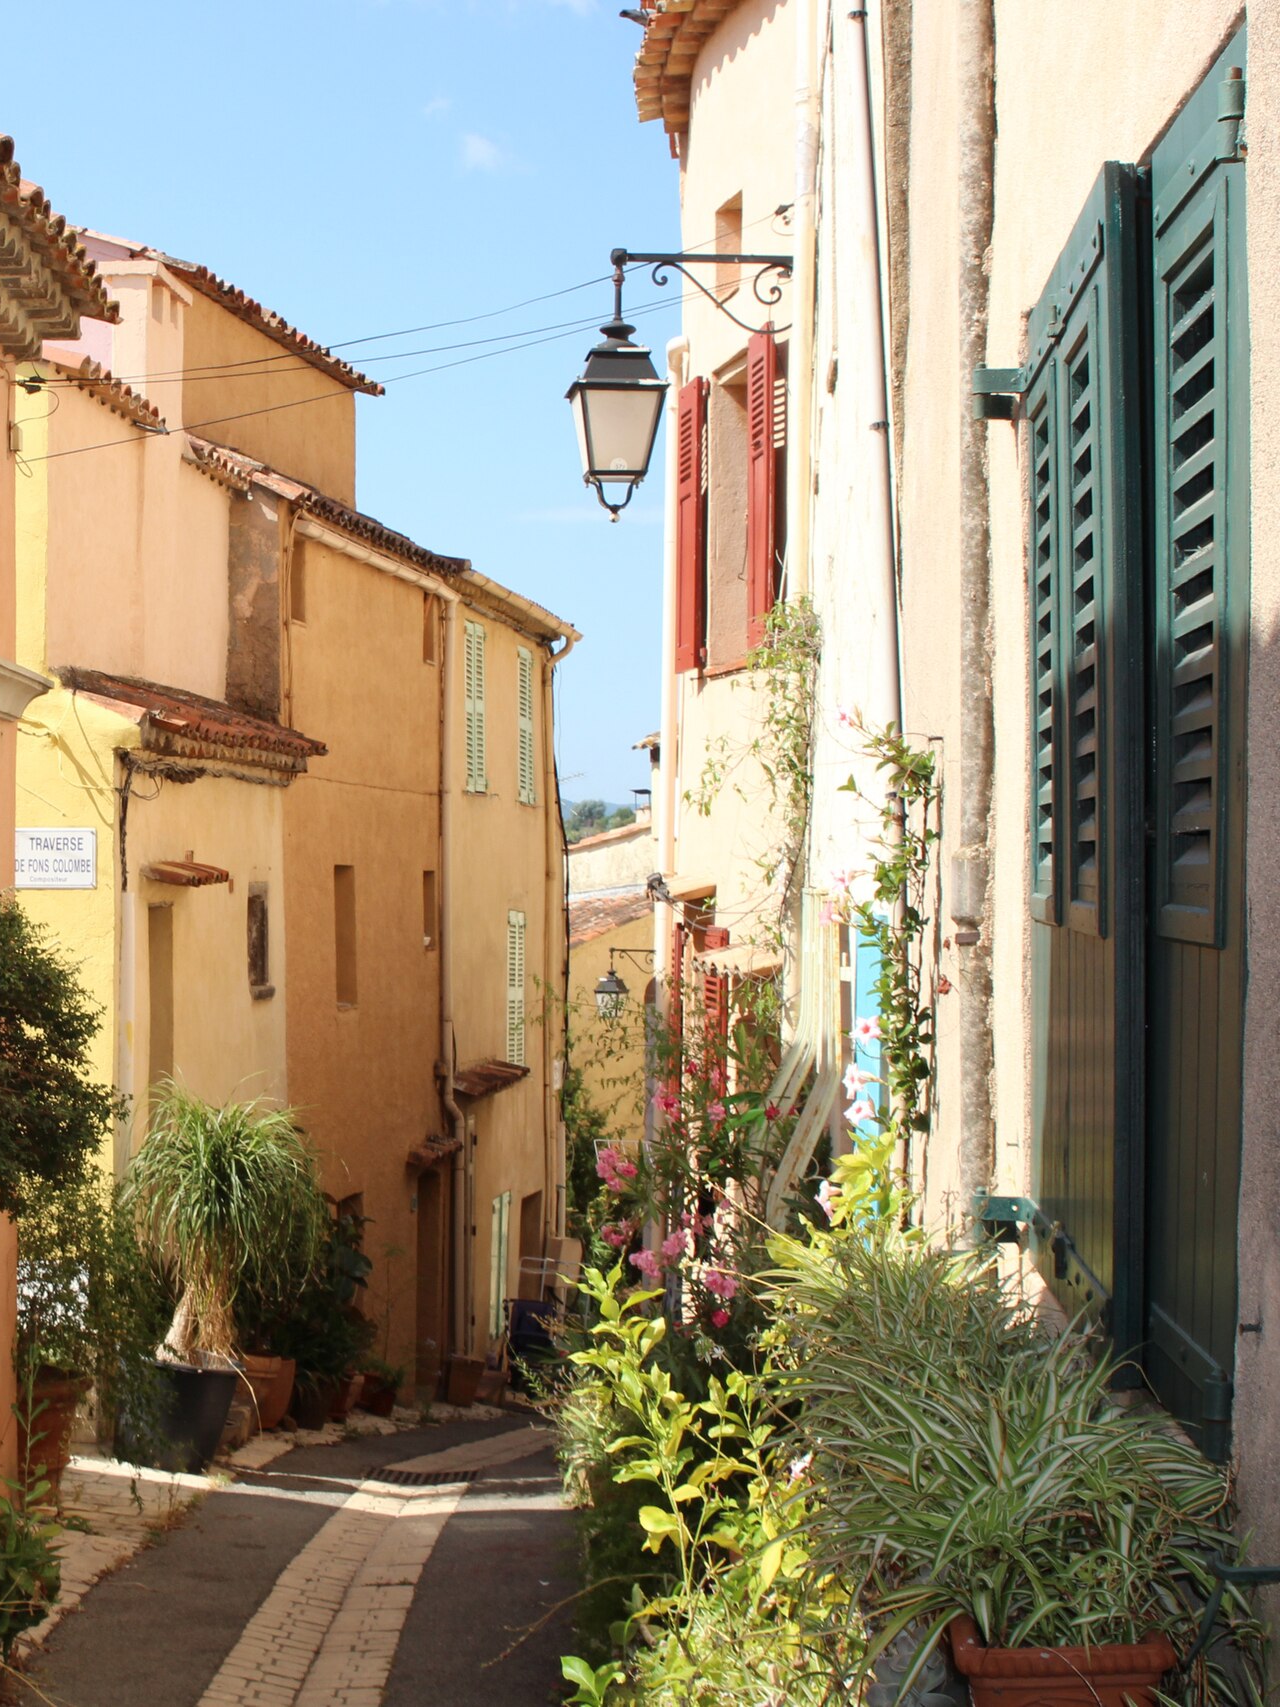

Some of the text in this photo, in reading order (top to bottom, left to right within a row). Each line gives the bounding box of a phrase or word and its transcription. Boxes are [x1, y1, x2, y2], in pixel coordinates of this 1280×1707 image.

[29, 837, 84, 851] TRAVERSE
[15, 859, 91, 873] DE FONS COLOMBE
